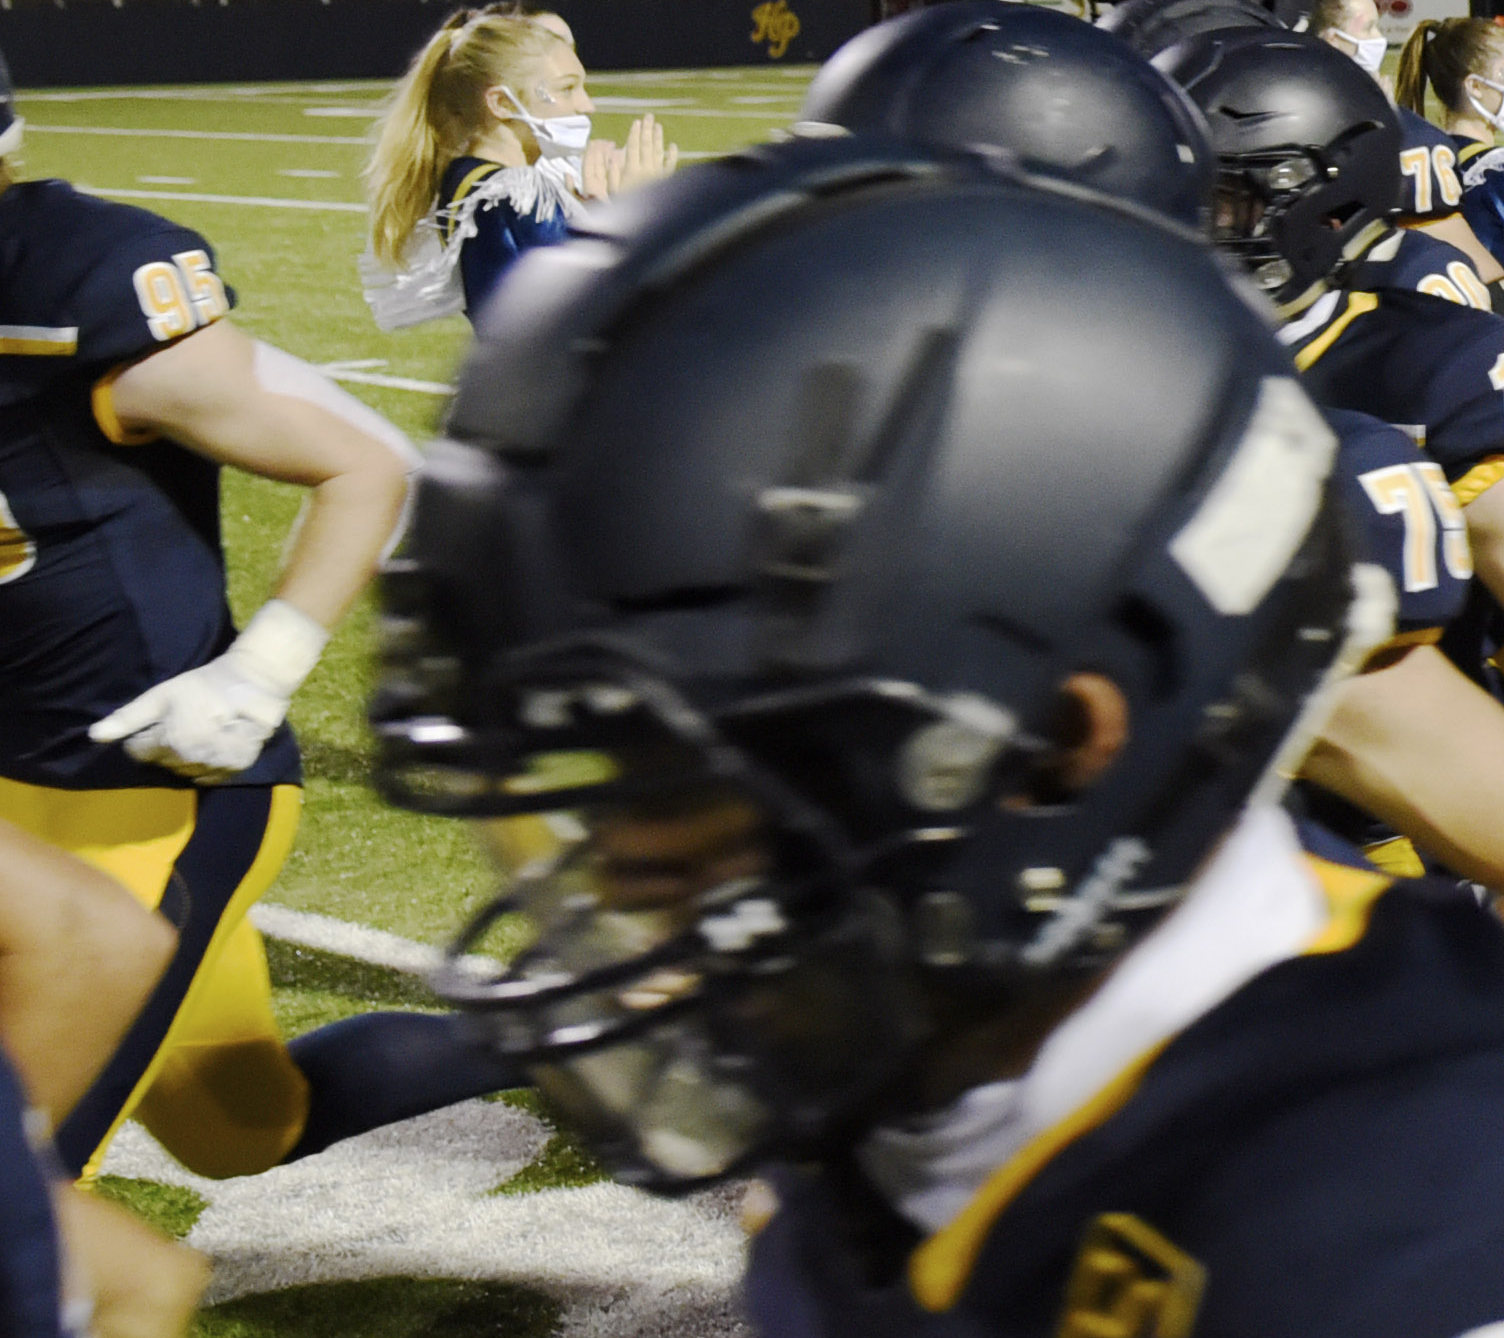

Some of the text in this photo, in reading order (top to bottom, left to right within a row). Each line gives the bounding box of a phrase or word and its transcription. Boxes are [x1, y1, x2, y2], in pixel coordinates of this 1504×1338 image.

[1400, 145, 1464, 212] 76
[132, 248, 230, 343] 95
[1357, 461, 1474, 593] 75
